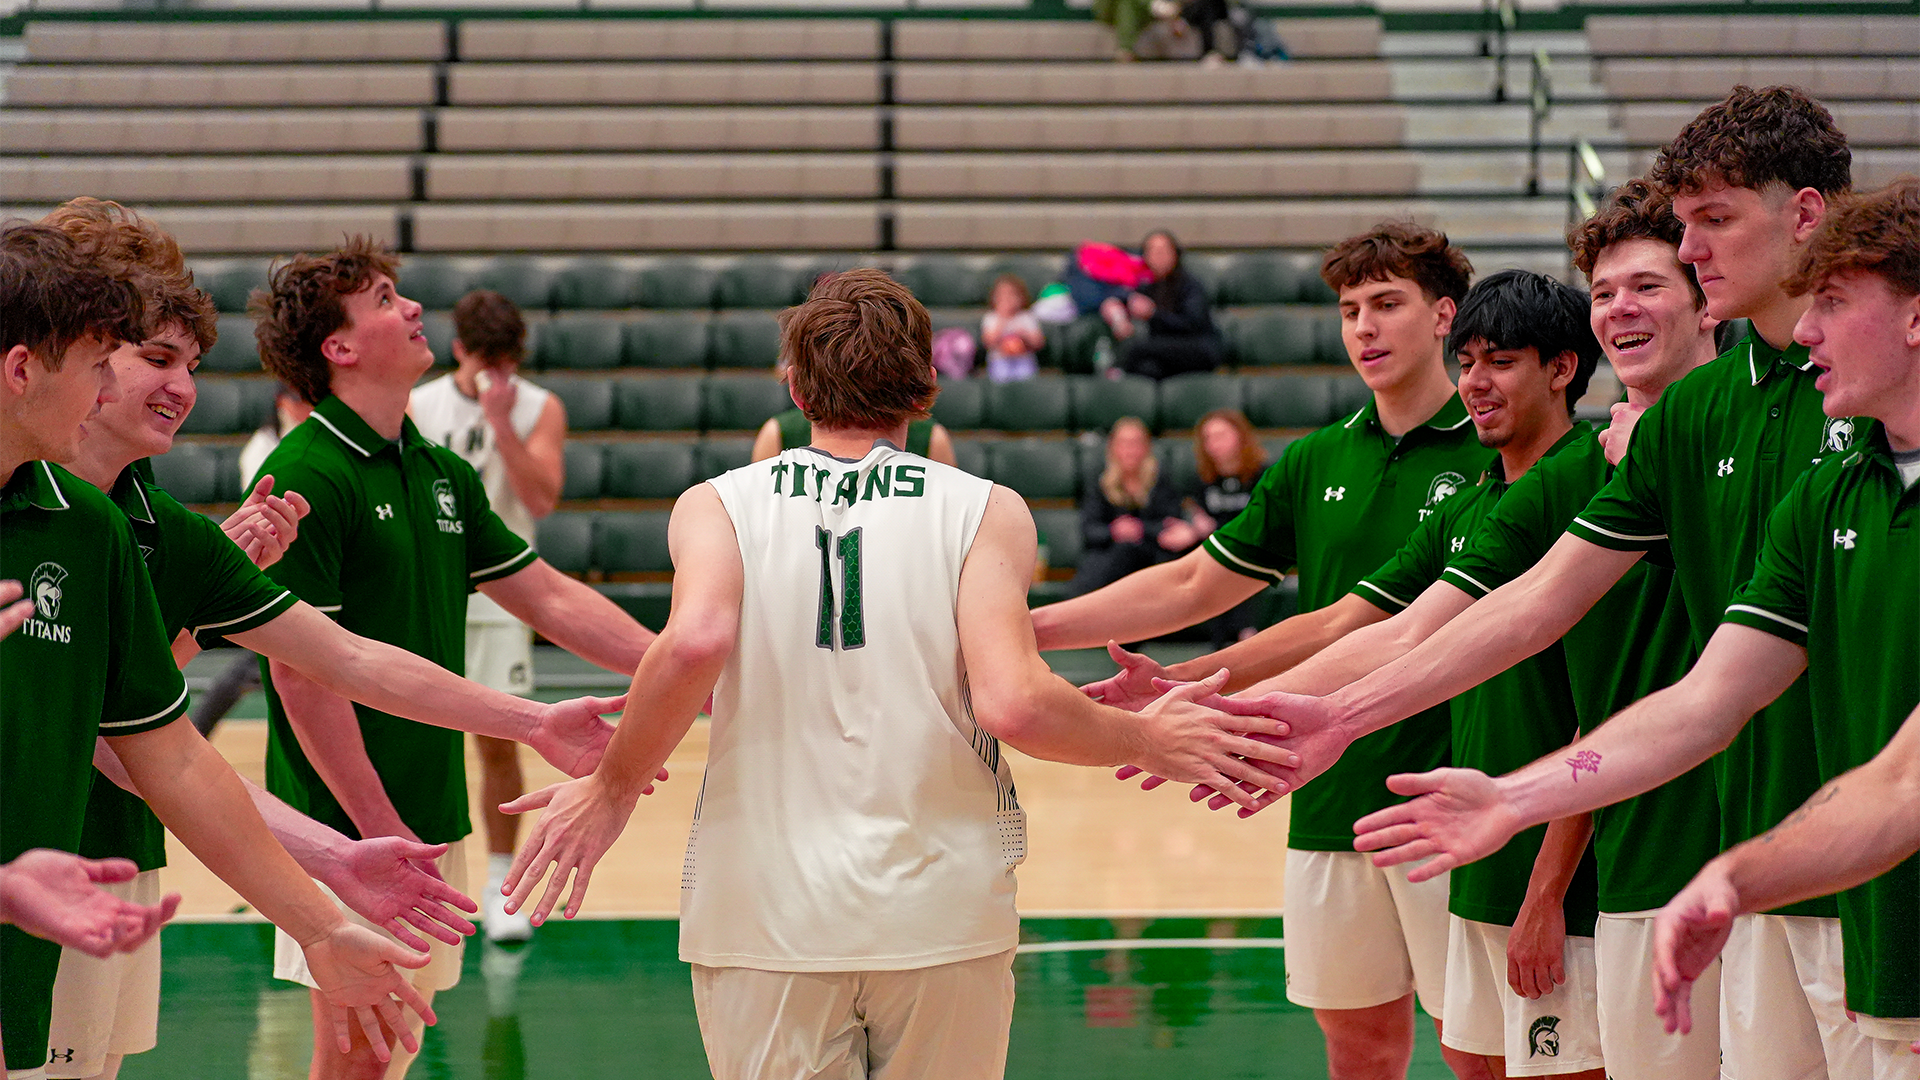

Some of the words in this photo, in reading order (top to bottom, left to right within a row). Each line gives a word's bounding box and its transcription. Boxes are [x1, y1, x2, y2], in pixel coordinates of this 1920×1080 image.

[771, 460, 926, 508] TITANS
[815, 525, 866, 652] 11
[22, 617, 71, 644] TITANS
